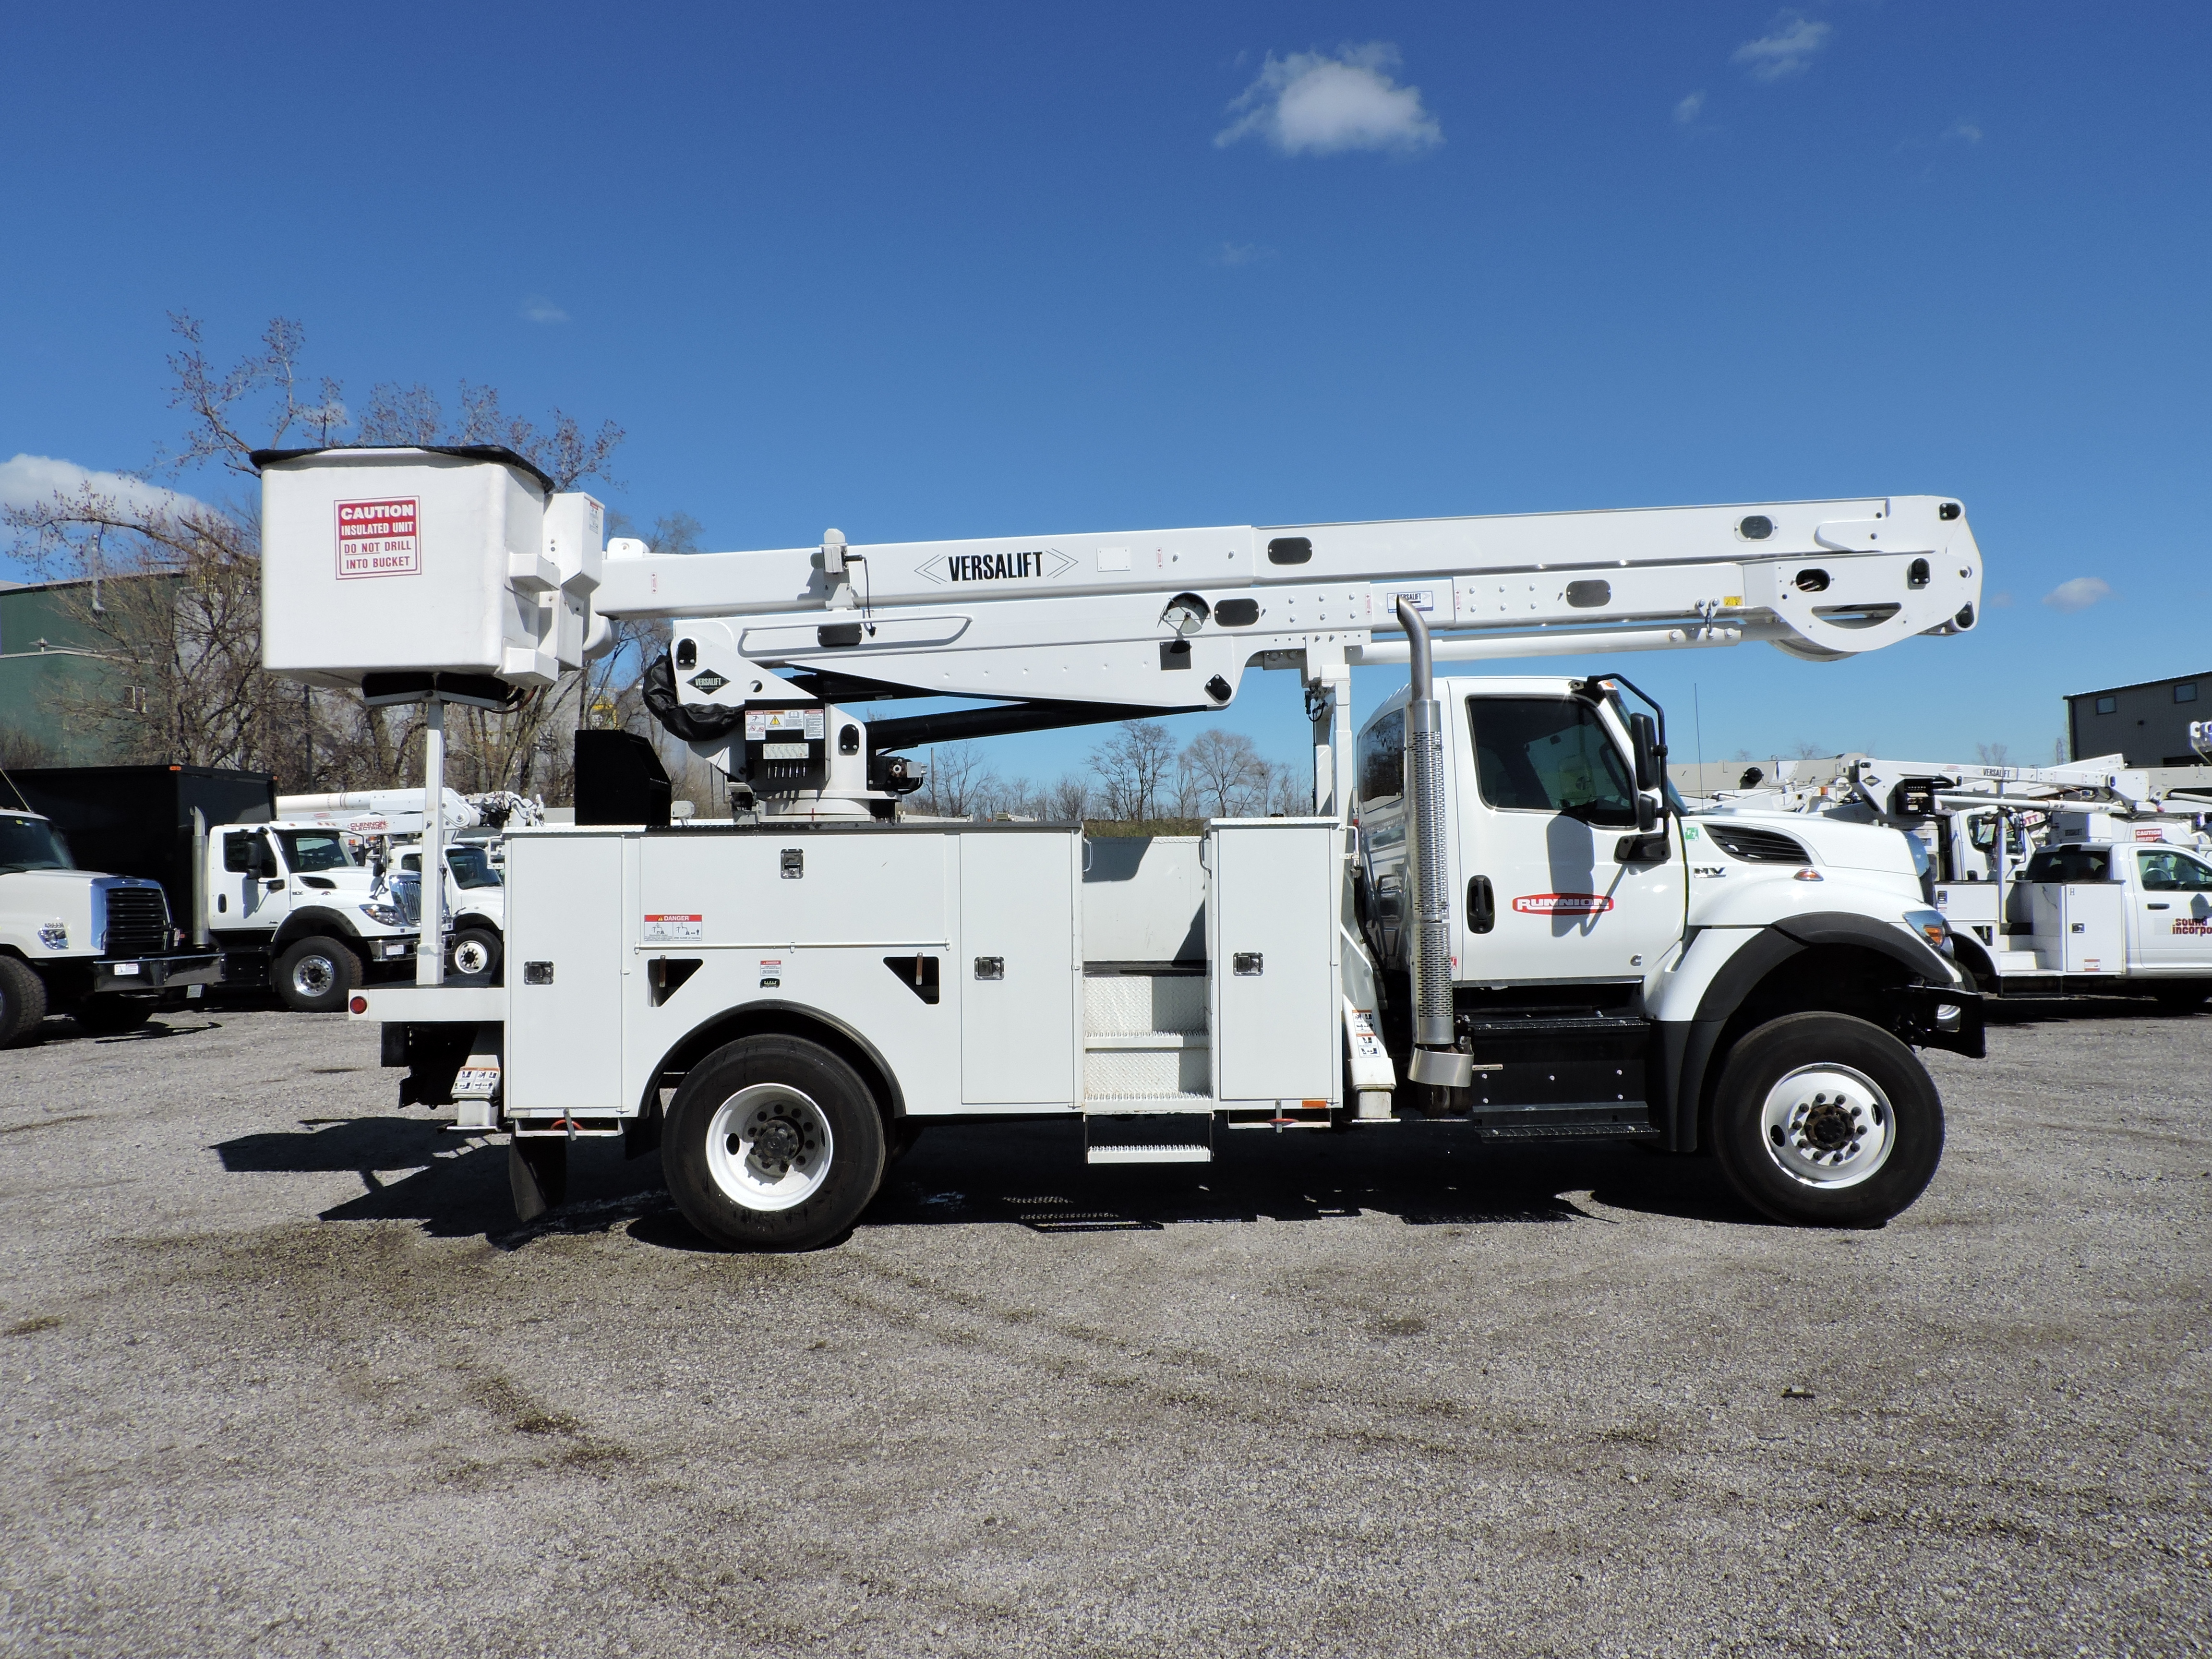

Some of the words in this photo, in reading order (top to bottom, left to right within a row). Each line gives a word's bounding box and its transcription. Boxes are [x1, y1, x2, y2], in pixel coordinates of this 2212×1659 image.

[341, 505, 413, 520] CAUTION
[341, 523, 389, 536] INSULATED
[392, 521, 414, 532] UNIT
[344, 544, 356, 553] DO
[361, 542, 380, 553] NOT
[385, 540, 412, 551] DRILL
[346, 558, 368, 569] INTO
[373, 556, 410, 567] BUCKET
[948, 551, 1043, 582] VERSALIFT
[695, 677, 721, 686] VERSALIFT
[1983, 768, 2010, 778] VERSALIFT
[1517, 899, 1609, 910] RUNNION
